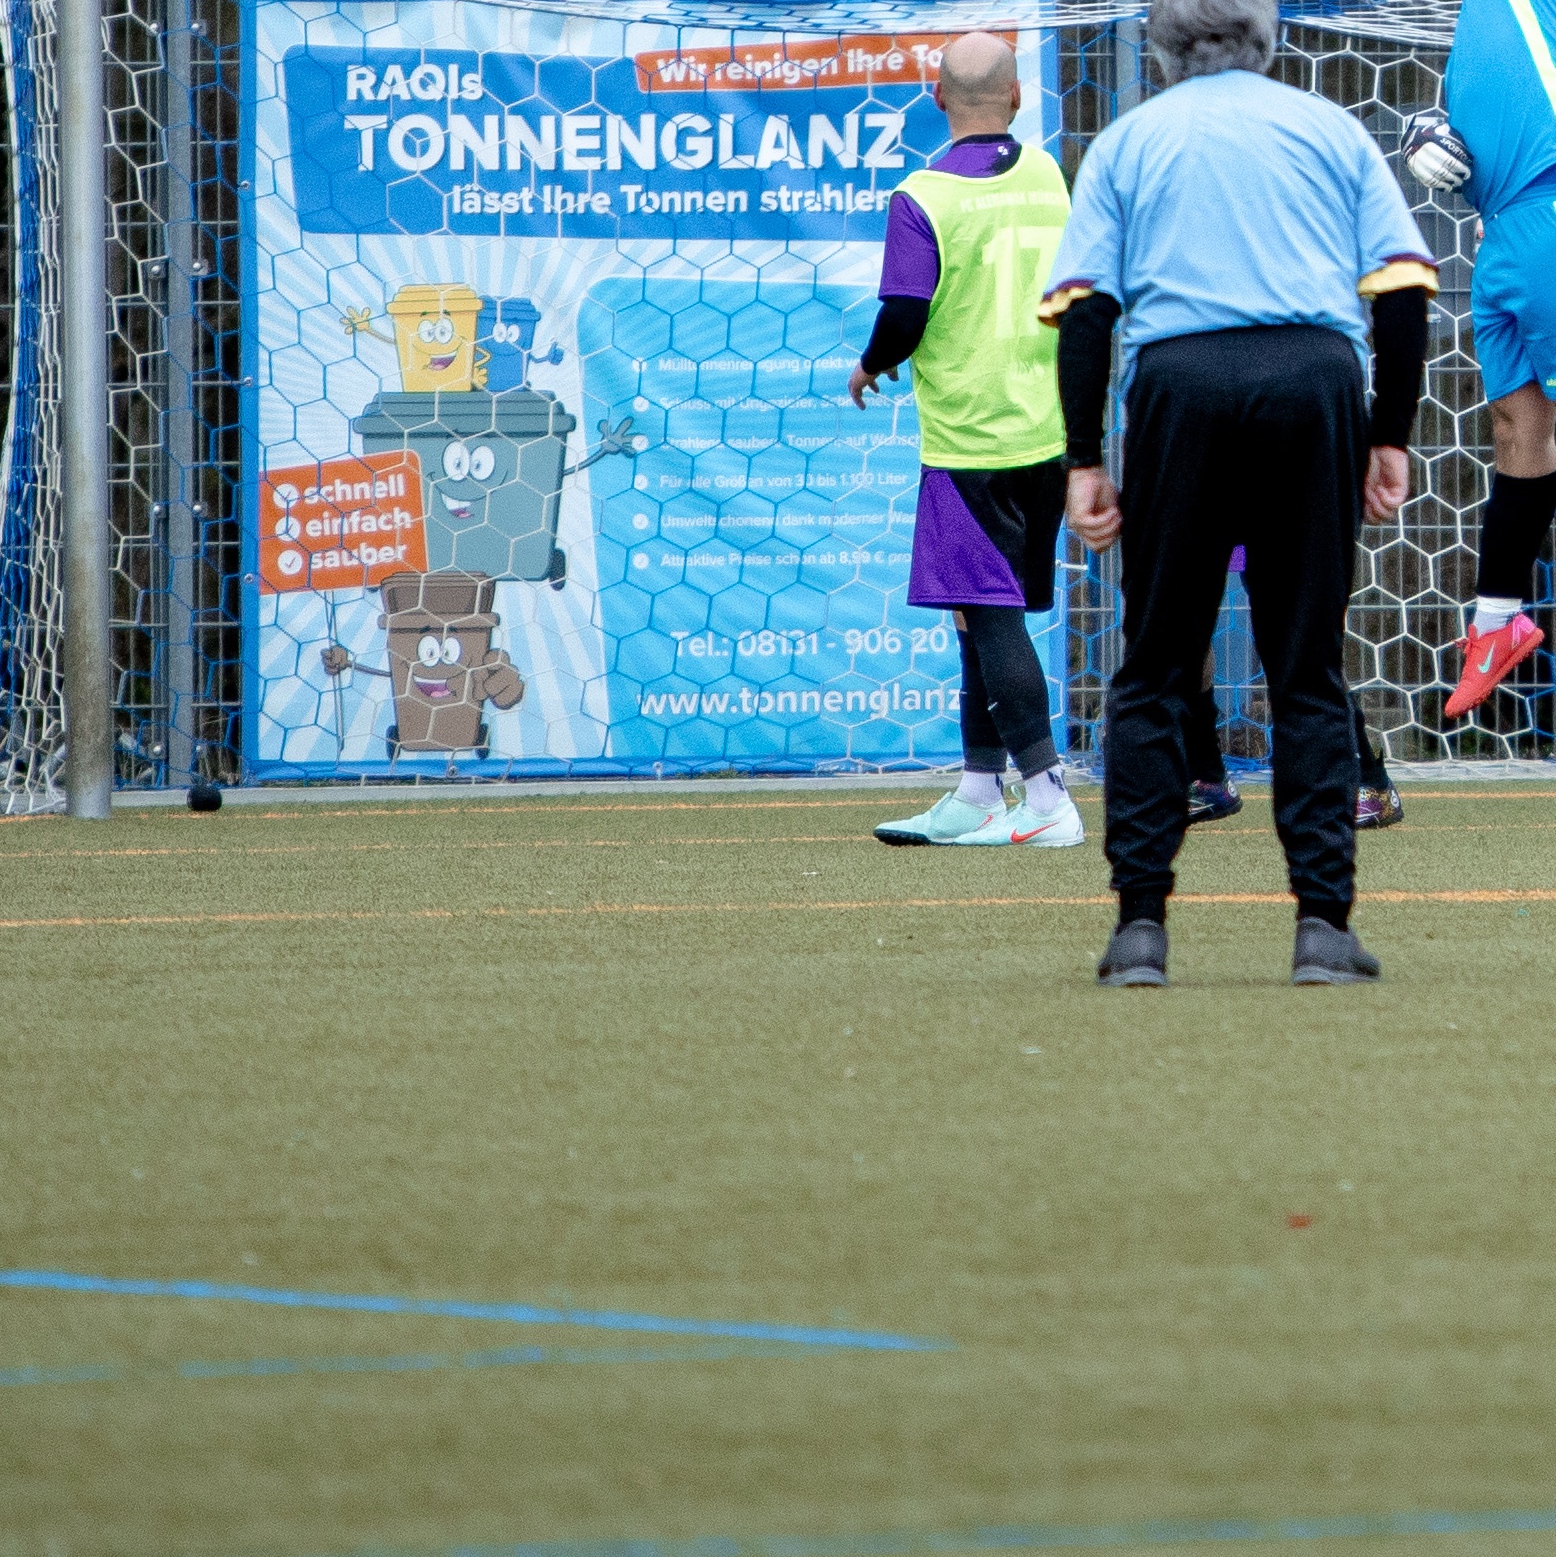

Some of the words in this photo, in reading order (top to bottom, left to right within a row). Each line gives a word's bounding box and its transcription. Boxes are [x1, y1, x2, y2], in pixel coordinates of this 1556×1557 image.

[657, 55, 707, 83] Wir
[715, 54, 838, 84] reinigen
[847, 48, 905, 73] Ihre
[912, 43, 943, 69] To
[346, 63, 484, 100] RAQIs
[343, 113, 907, 171] TONNENGLANZ
[453, 183, 534, 214] lässt
[543, 184, 612, 214] Ihre
[620, 183, 748, 214] Tonnen
[982, 225, 1068, 339] 17
[303, 474, 405, 505] schnell
[660, 474, 683, 488] Für
[767, 476, 792, 488] von
[816, 472, 837, 487] bis
[877, 471, 908, 485] Liter
[305, 506, 412, 538] einfach
[782, 512, 815, 526] dank
[310, 542, 407, 570] sauber
[661, 552, 725, 566] Attraktive
[819, 551, 837, 564] ab
[873, 550, 885, 564] €
[669, 630, 728, 657] Tel.:
[736, 629, 819, 657] 08131
[843, 628, 901, 655] 906
[910, 627, 949, 654] 20
[636, 683, 962, 718] www.tonnenglanz
